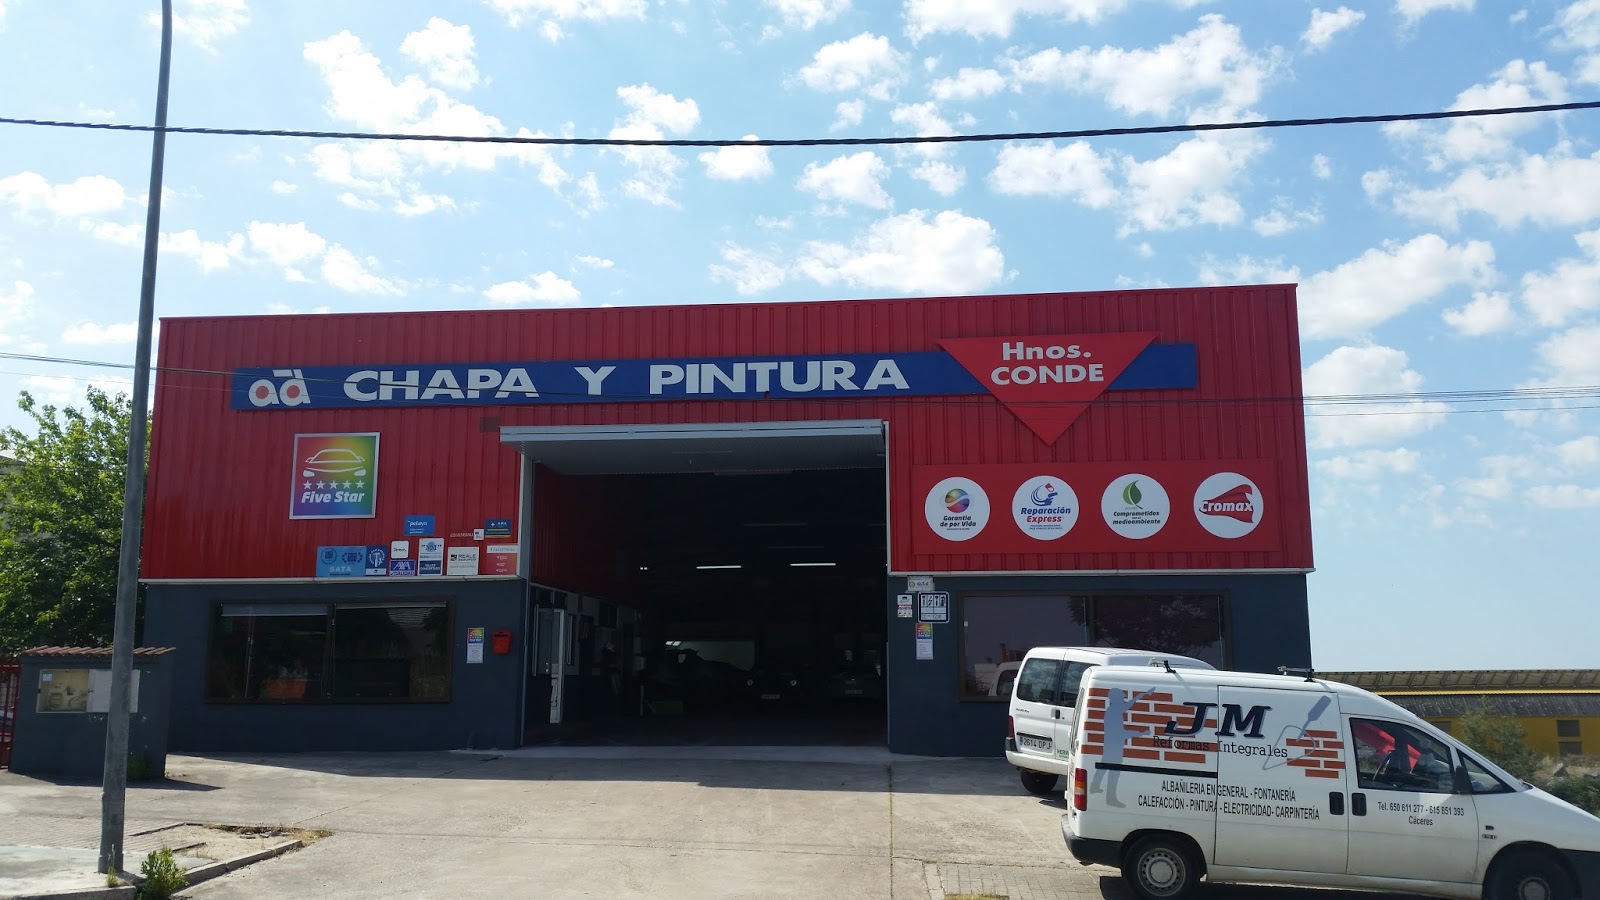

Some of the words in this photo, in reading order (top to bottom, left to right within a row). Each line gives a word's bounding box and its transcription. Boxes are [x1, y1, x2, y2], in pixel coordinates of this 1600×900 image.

[1002, 341, 1091, 360] Hnos.
[343, 368, 539, 401] CHAPA
[574, 366, 617, 395] Y
[650, 359, 910, 394] PINTURA
[990, 363, 1104, 385] CONDE
[301, 491, 331, 503] Five
[334, 491, 365, 503] Star
[1020, 507, 1071, 516] Reparación
[1200, 501, 1253, 512] Cromax
[1026, 515, 1062, 523] Express
[393, 561, 411, 571] AXA
[1152, 736, 1210, 750] Reformas
[1217, 740, 1288, 758] Integrales
[1206, 783, 1216, 795] EN
[1217, 784, 1249, 798] GENERAL
[1254, 786, 1297, 802] FONTANERÍA
[1138, 794, 1185, 810] CALEFACCIÓN
[1189, 799, 1217, 812] PINTURA
[1275, 805, 1321, 821] CARPINTERÍA
[1378, 801, 1388, 811] Tel.
[1389, 803, 1400, 812] 650
[1401, 804, 1412, 812] 611
[1413, 804, 1424, 813] 277
[1453, 807, 1465, 816] 393
[1408, 815, 1434, 826] Cáceres
